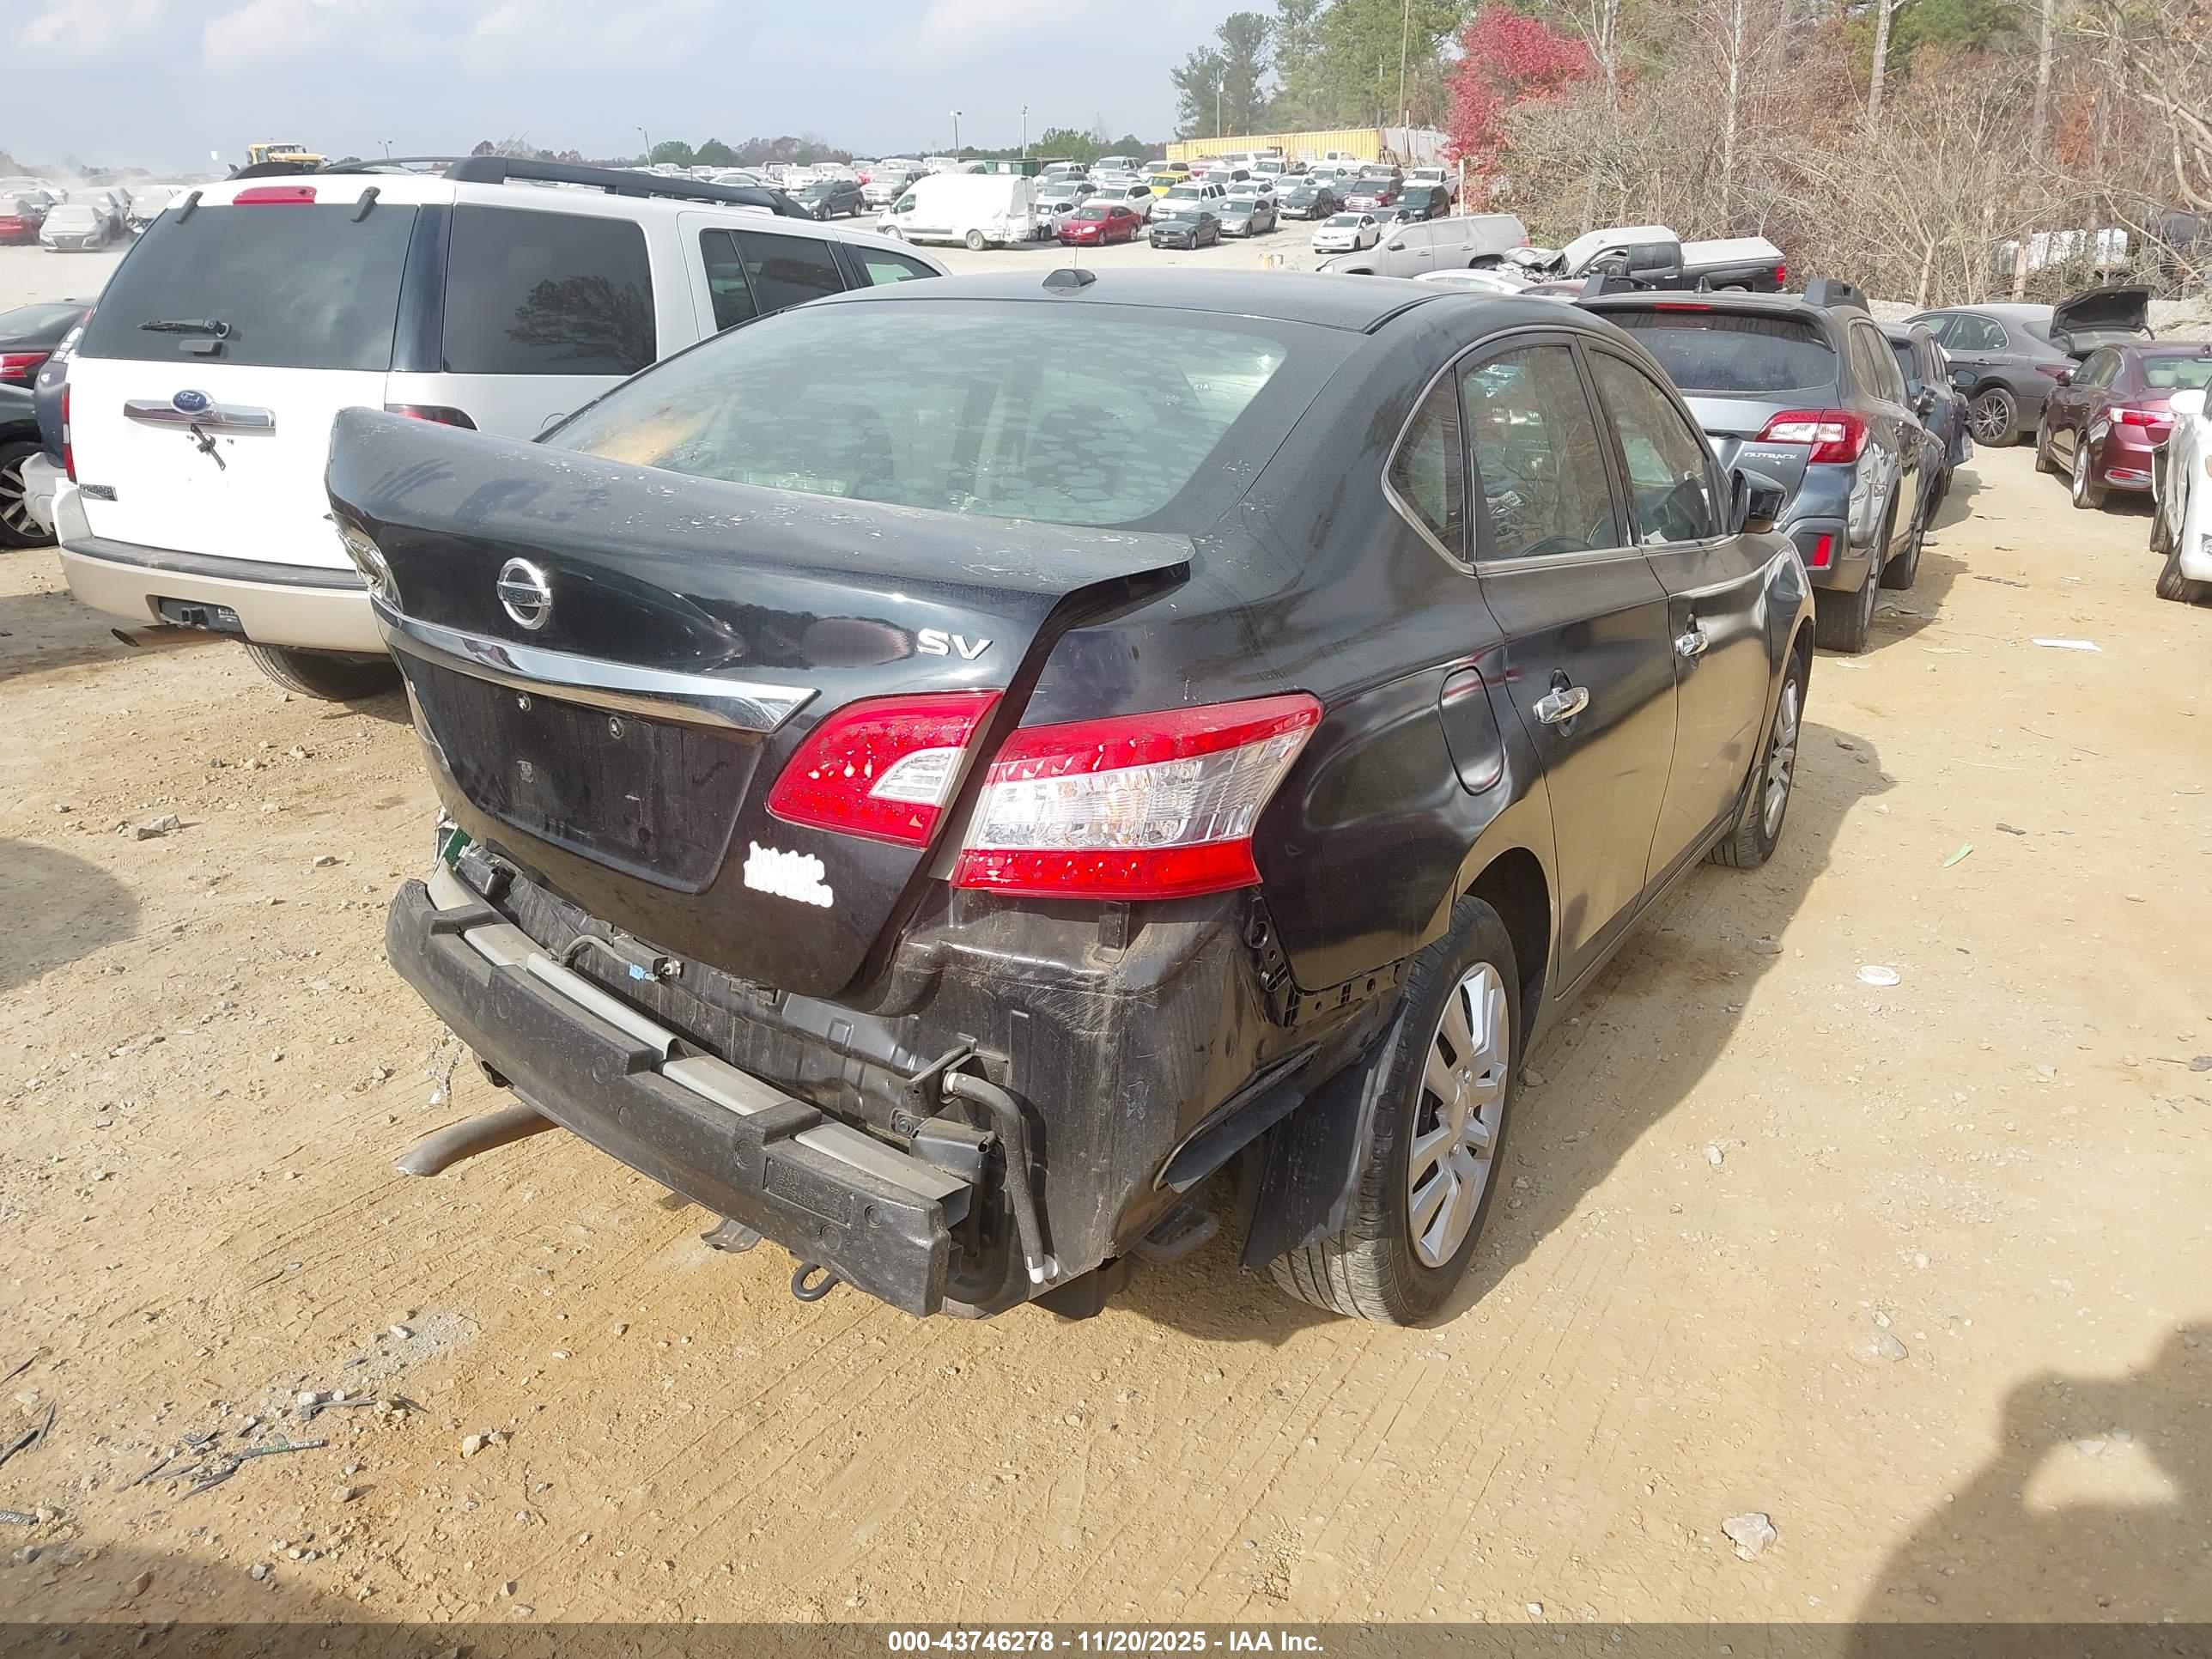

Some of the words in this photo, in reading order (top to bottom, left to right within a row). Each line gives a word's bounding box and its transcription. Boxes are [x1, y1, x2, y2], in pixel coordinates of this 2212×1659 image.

[177, 392, 201, 404] Ford
[497, 585, 541, 604] NISSAN
[916, 628, 994, 660] SV
